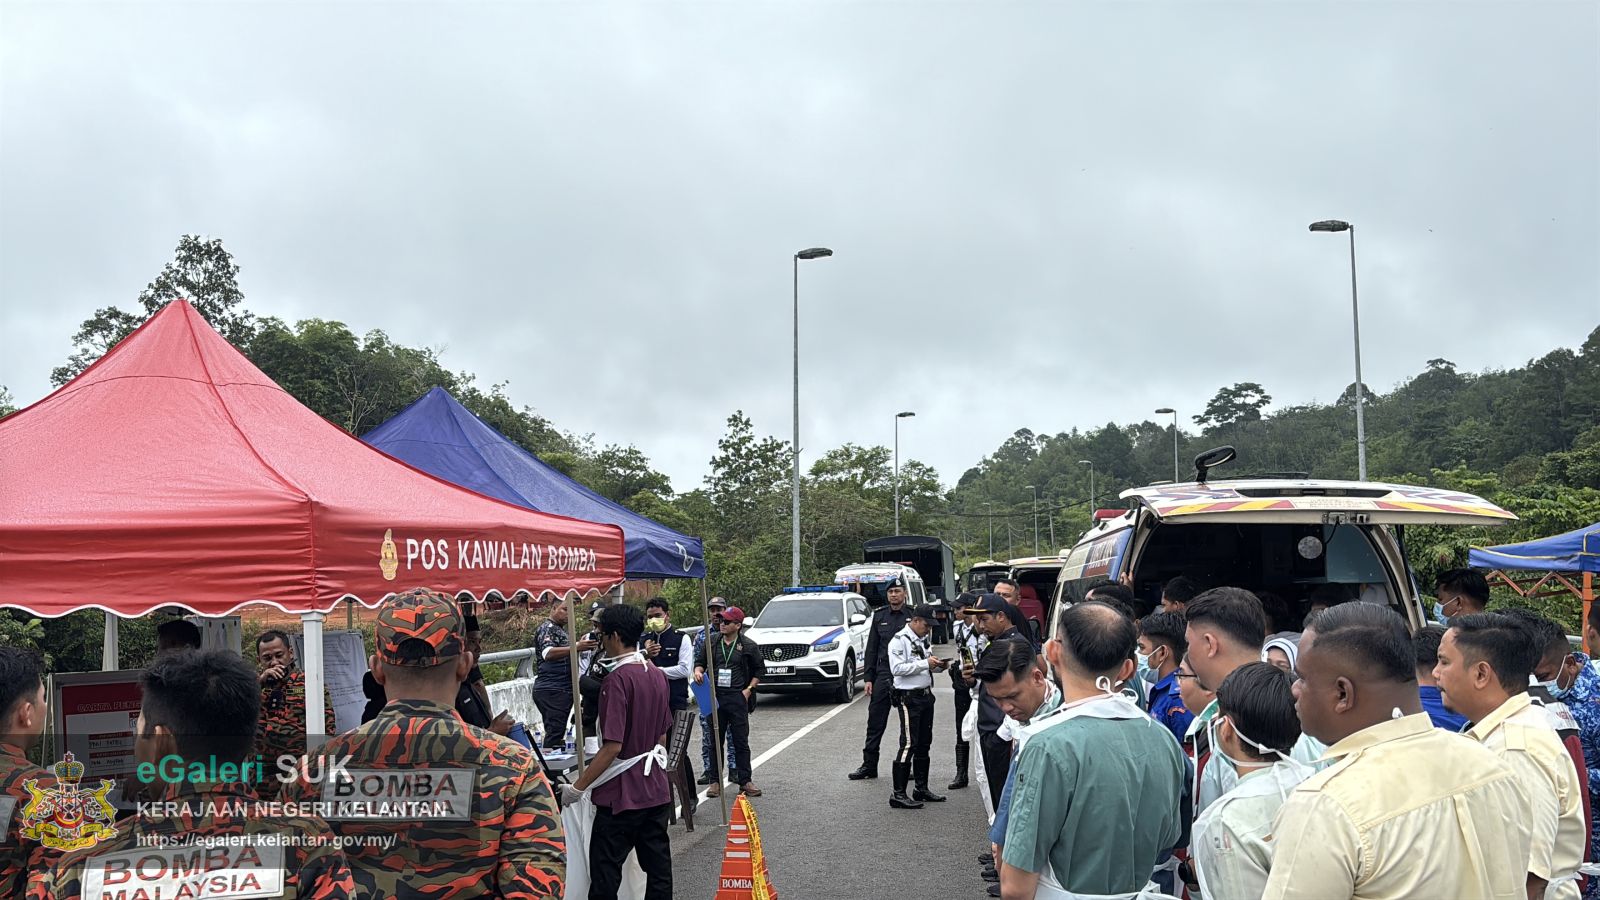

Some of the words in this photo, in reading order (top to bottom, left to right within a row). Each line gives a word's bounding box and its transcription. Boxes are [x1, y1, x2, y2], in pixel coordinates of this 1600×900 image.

[406, 538, 449, 570] POS
[458, 540, 541, 570] KAWALAN
[547, 545, 596, 572] BOMBA
[335, 773, 458, 798] BOMBA
[103, 845, 263, 885] BOMBA
[102, 872, 263, 900] MALAYSIA
[722, 878, 753, 889] BOMBA
